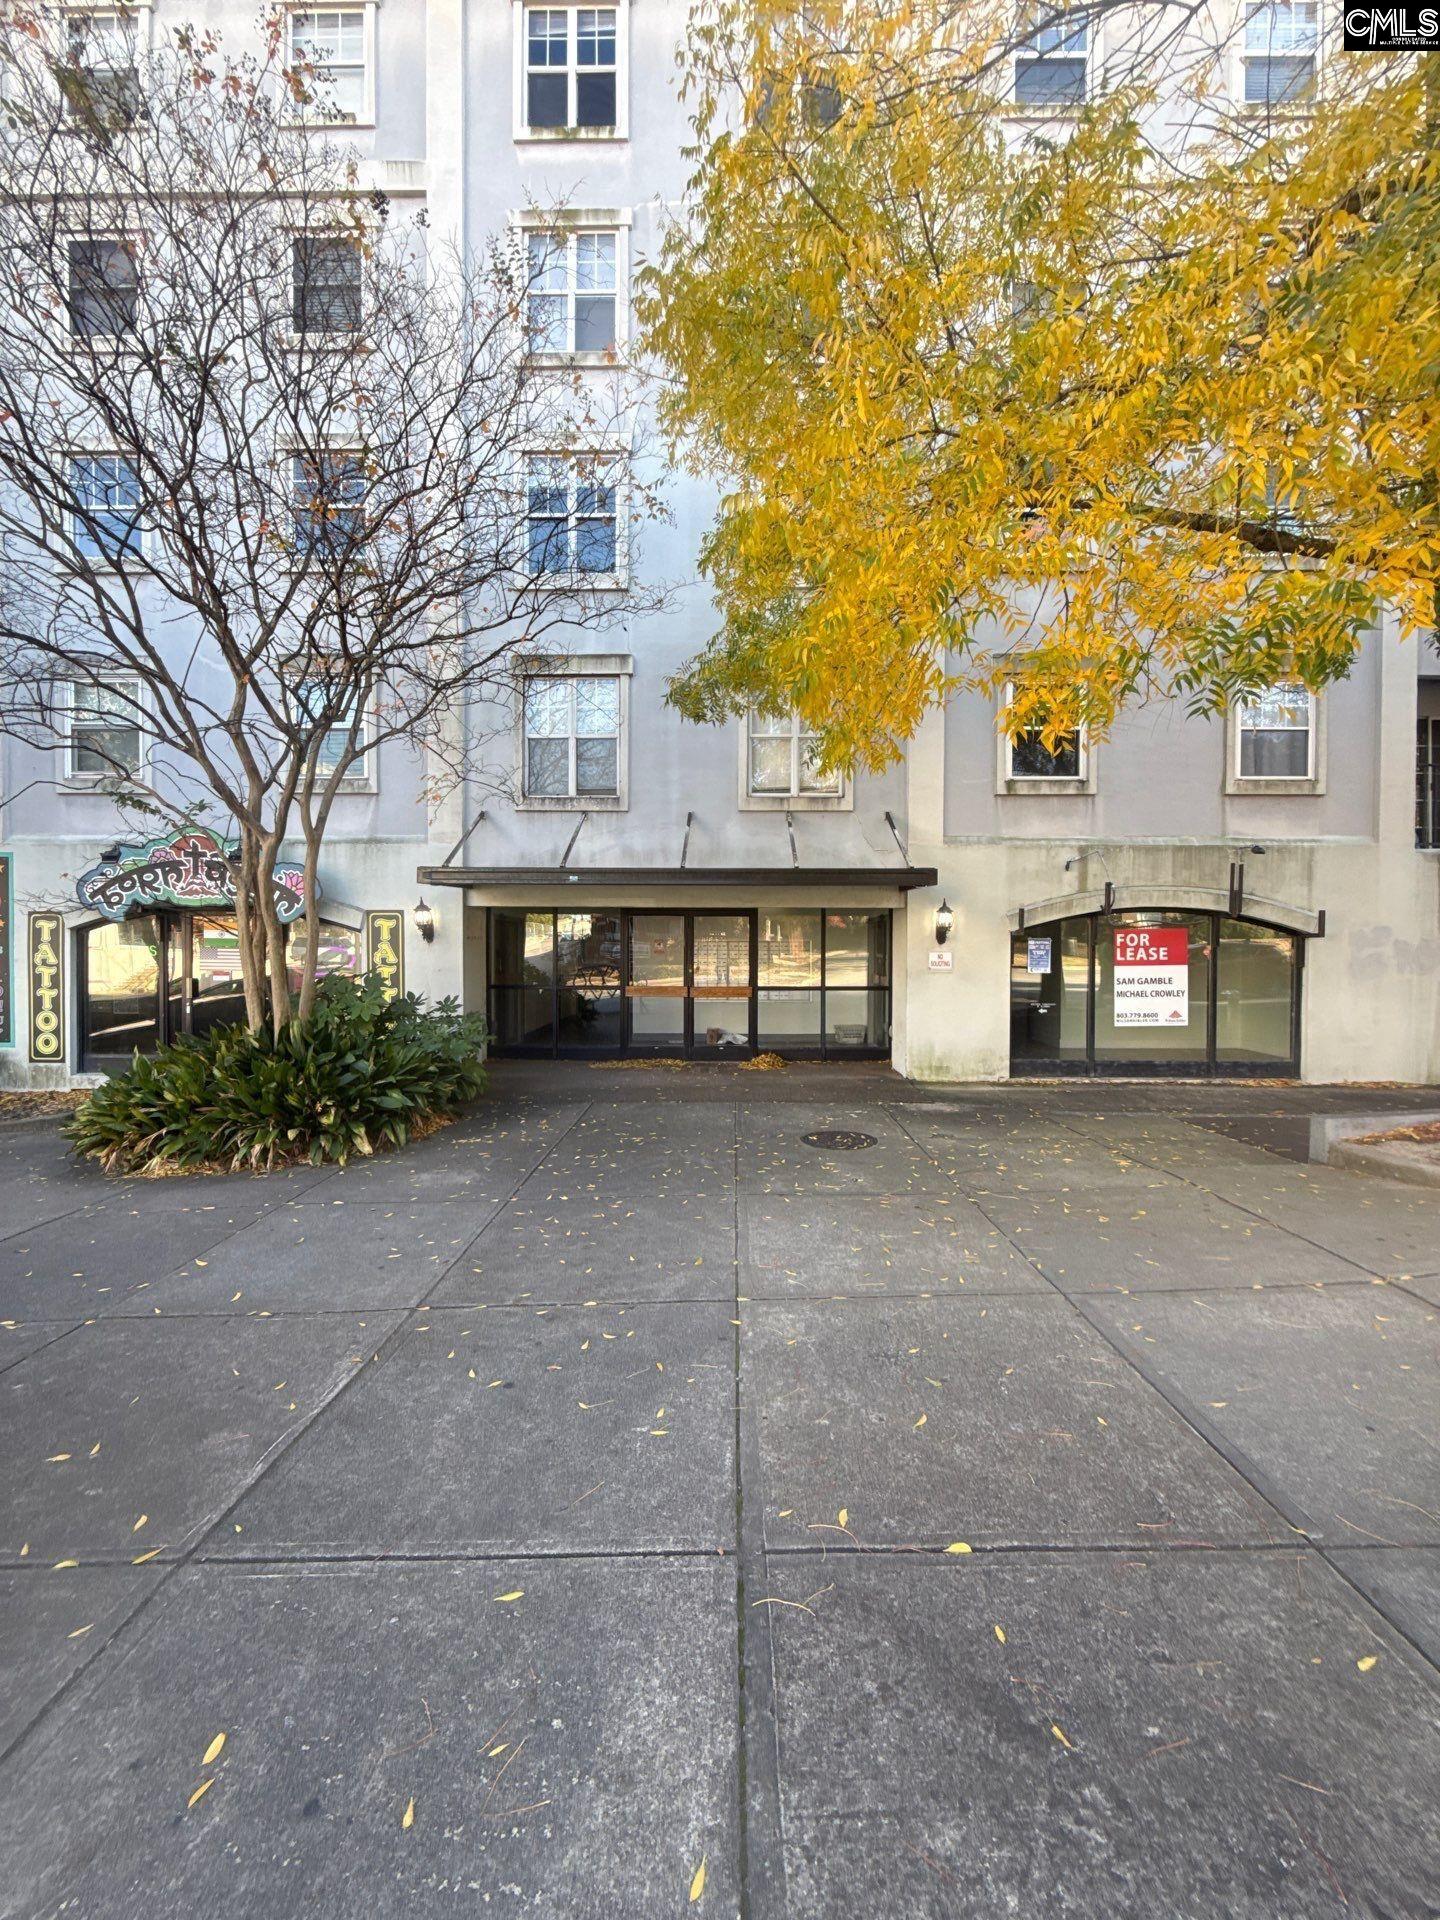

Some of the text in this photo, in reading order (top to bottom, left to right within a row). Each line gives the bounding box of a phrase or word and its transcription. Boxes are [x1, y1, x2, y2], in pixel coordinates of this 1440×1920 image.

[1116, 933, 1150, 947] FOR
[373, 917, 399, 1004] TATT
[1116, 947, 1169, 961] LEASE
[34, 919, 59, 1055] TATTOO
[1116, 977, 1173, 985] SAM GAMBLE
[1116, 990, 1185, 998] MICHAEL CROWLEY
